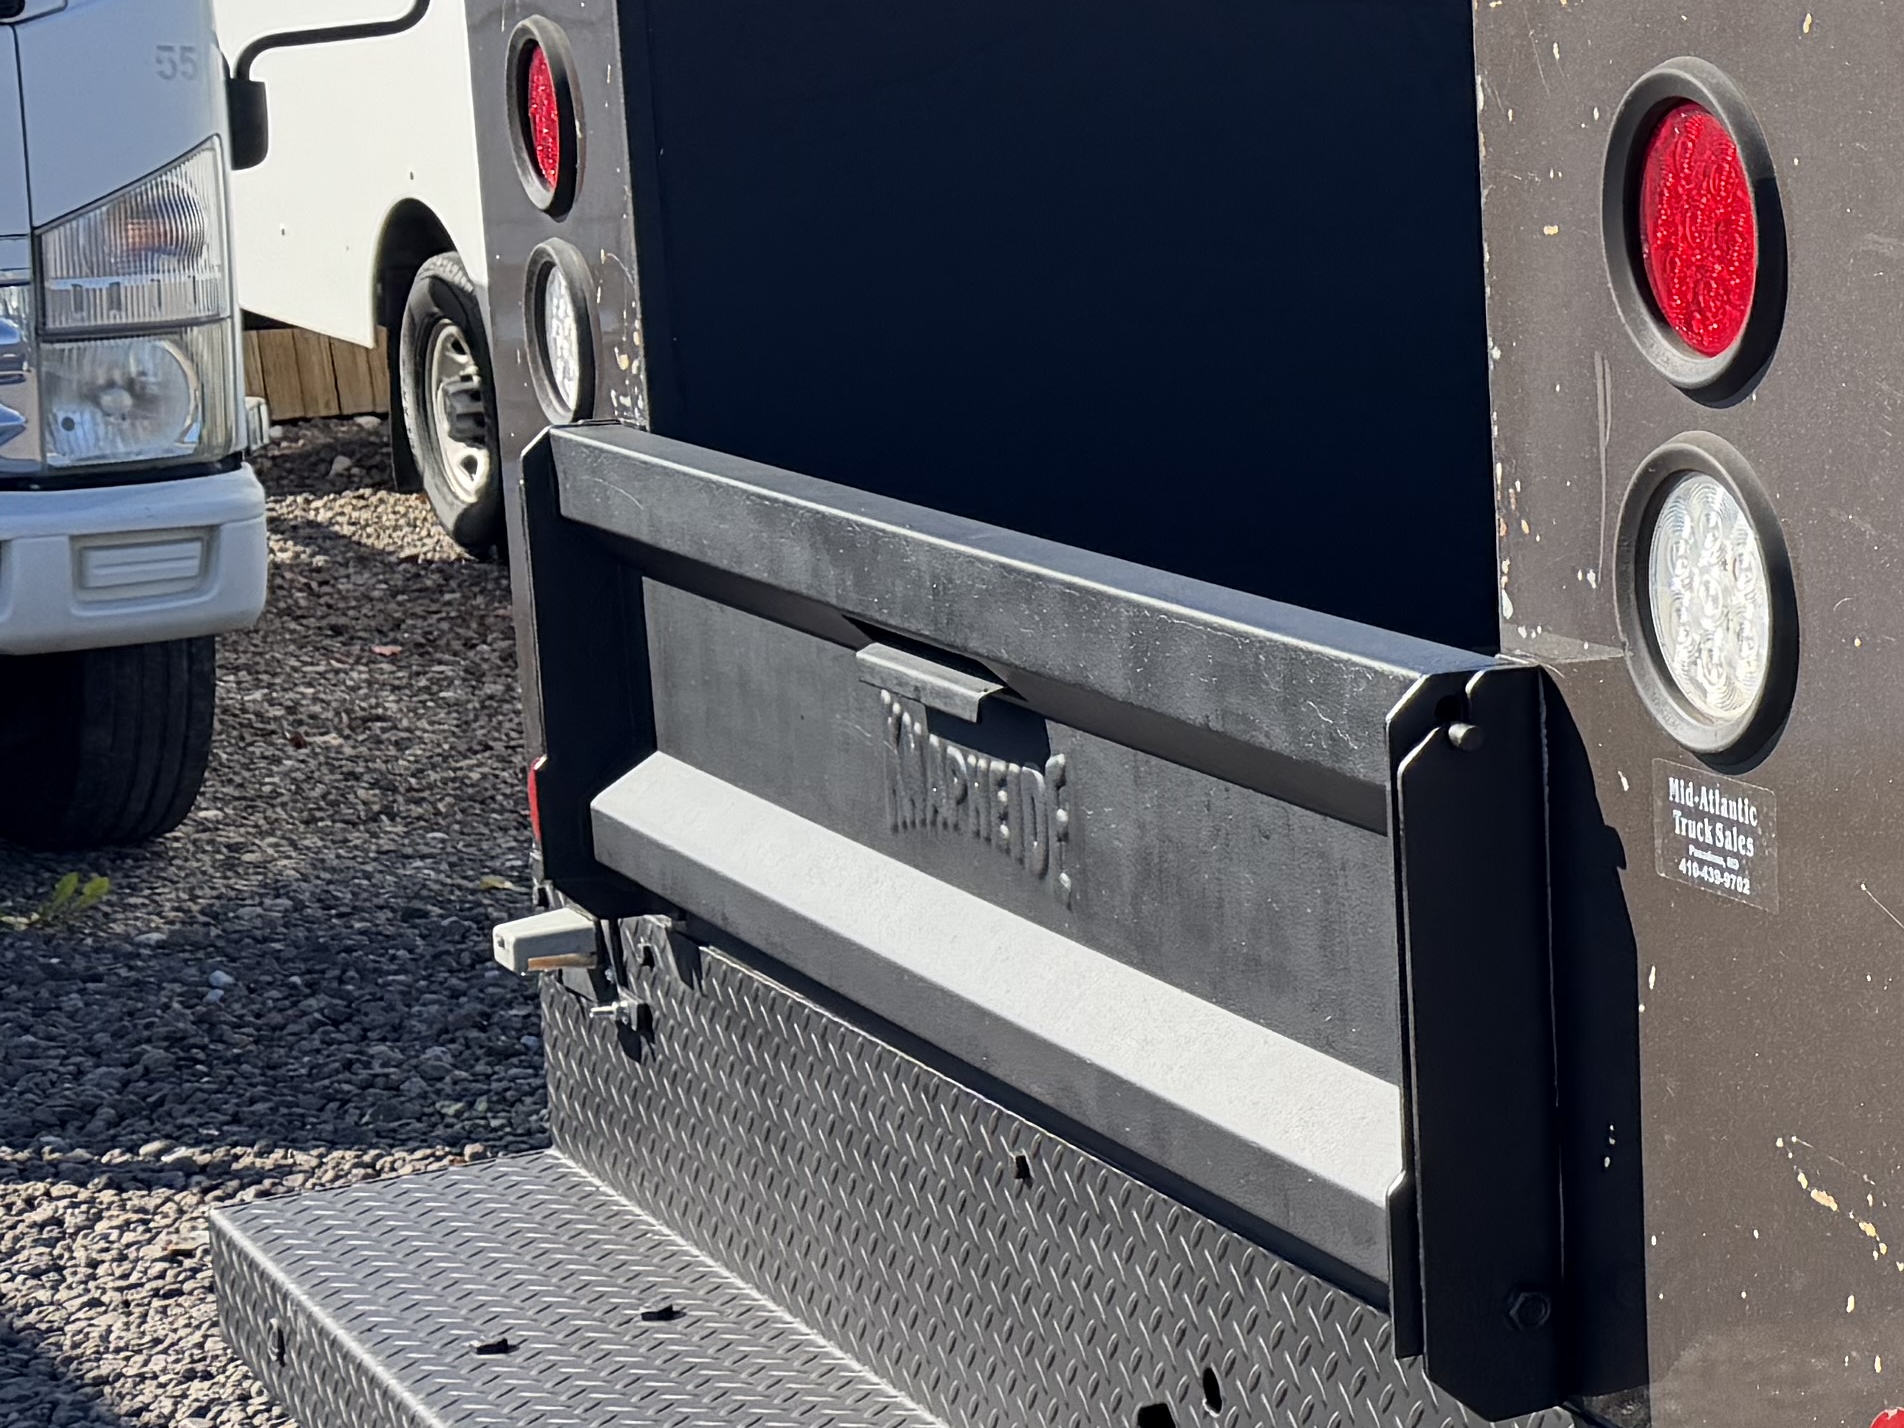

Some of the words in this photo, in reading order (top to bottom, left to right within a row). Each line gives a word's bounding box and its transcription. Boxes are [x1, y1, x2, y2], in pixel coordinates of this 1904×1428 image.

[1668, 776, 1758, 828] Mid-Atlantic
[1672, 809, 1714, 846] Truck
[1714, 821, 1755, 858] Sales
